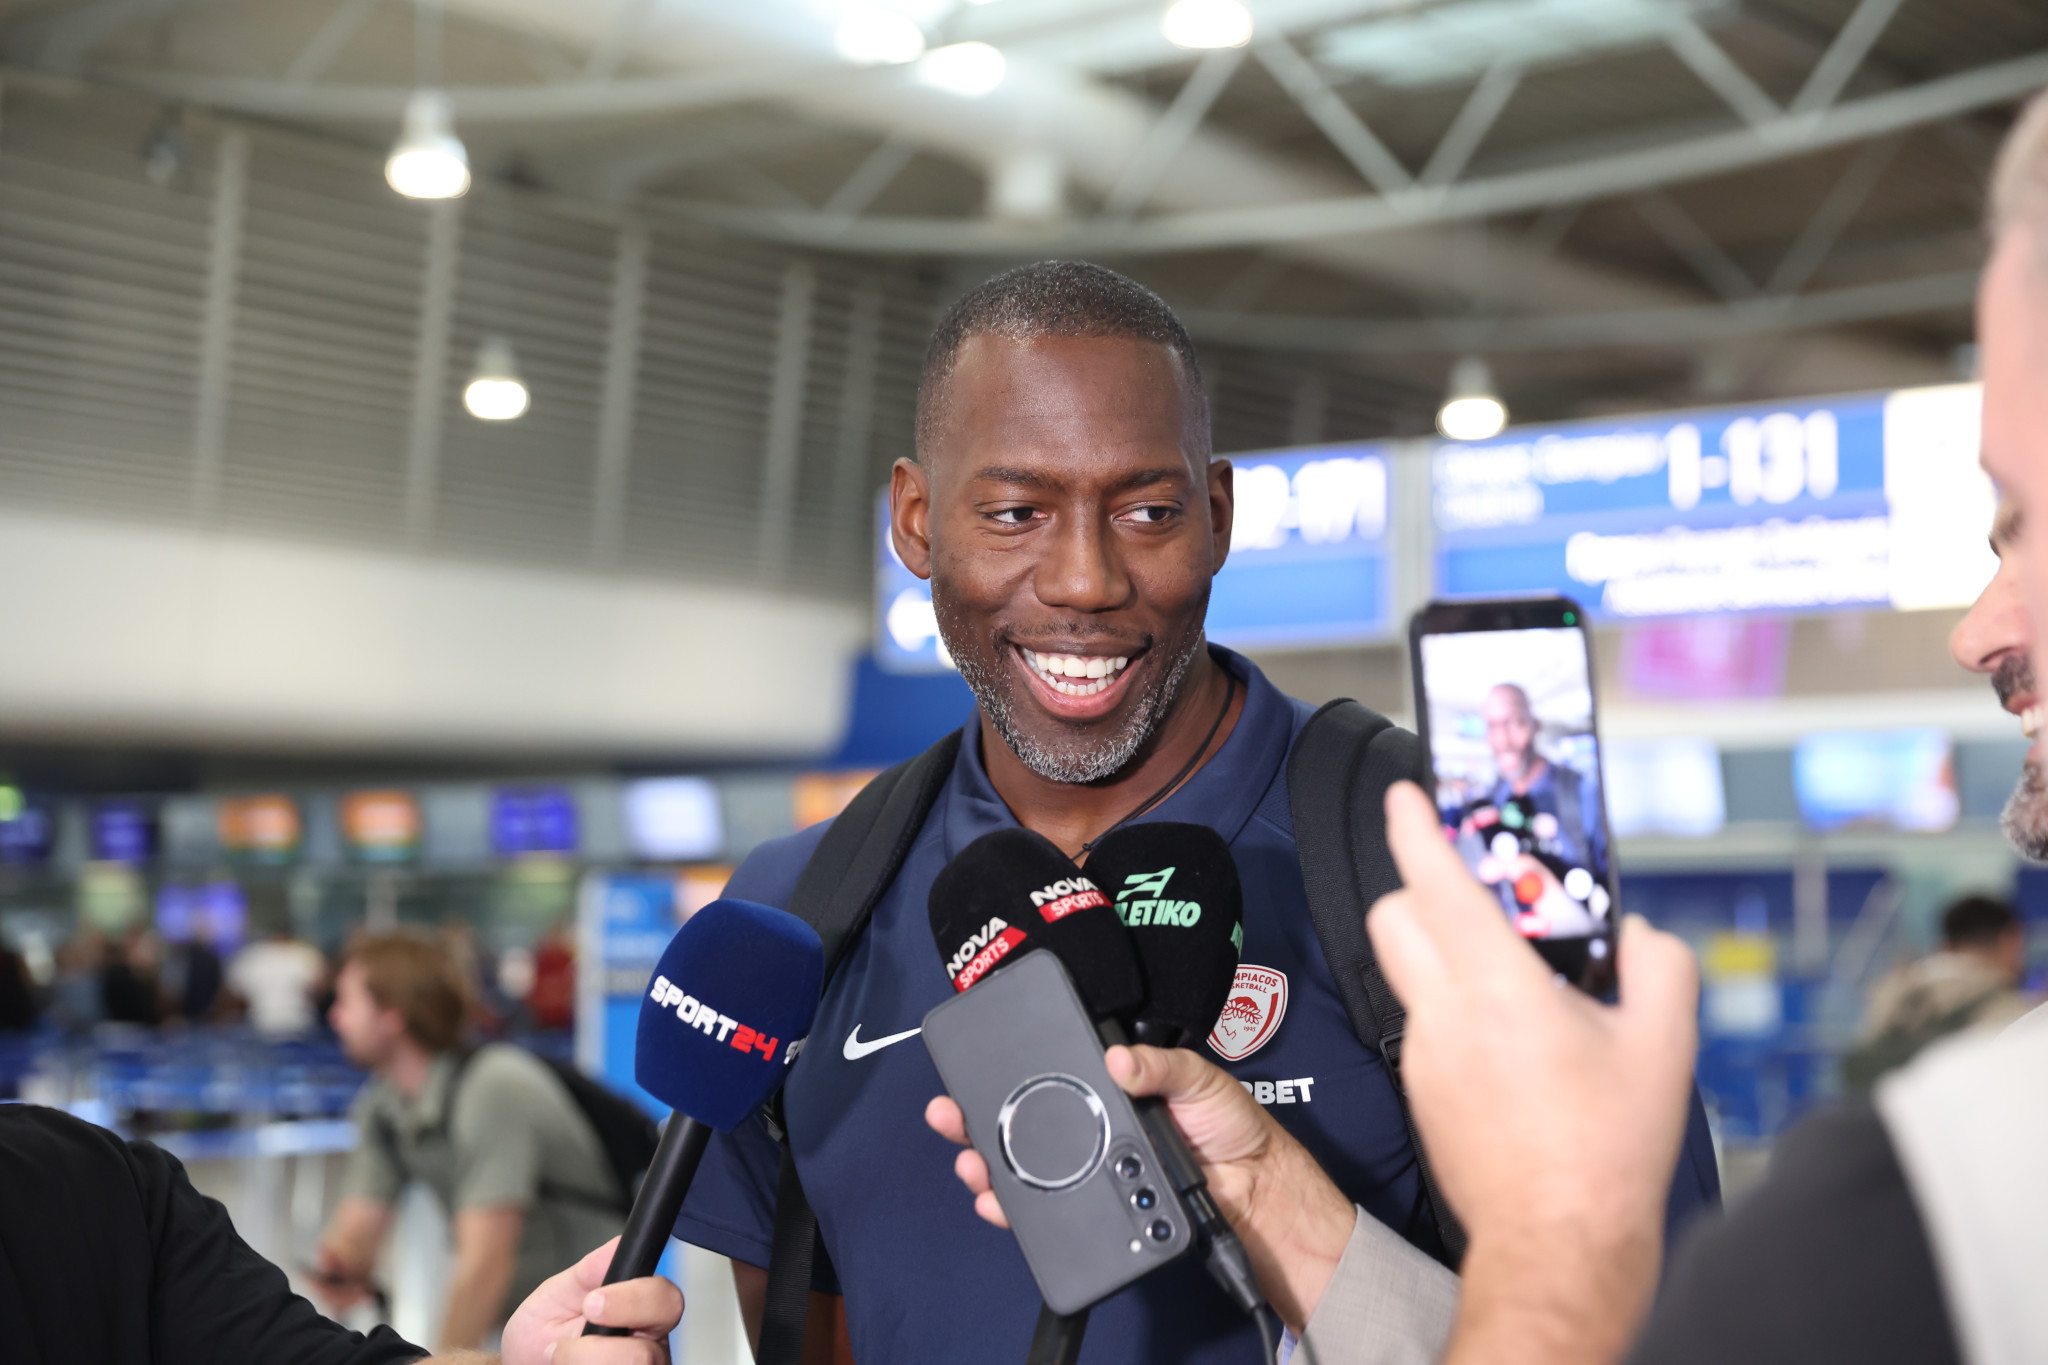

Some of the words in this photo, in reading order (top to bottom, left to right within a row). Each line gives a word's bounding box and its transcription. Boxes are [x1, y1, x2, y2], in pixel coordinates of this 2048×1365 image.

[1029, 877, 1099, 907] NOVA
[1051, 891, 1104, 917] SPORTS
[946, 917, 1008, 980] NOVA
[959, 937, 1010, 989] SPORTS
[1231, 982, 1267, 994] SKETBALL
[1234, 972, 1278, 987] MPIACOS
[650, 975, 779, 1062] SPORT24
